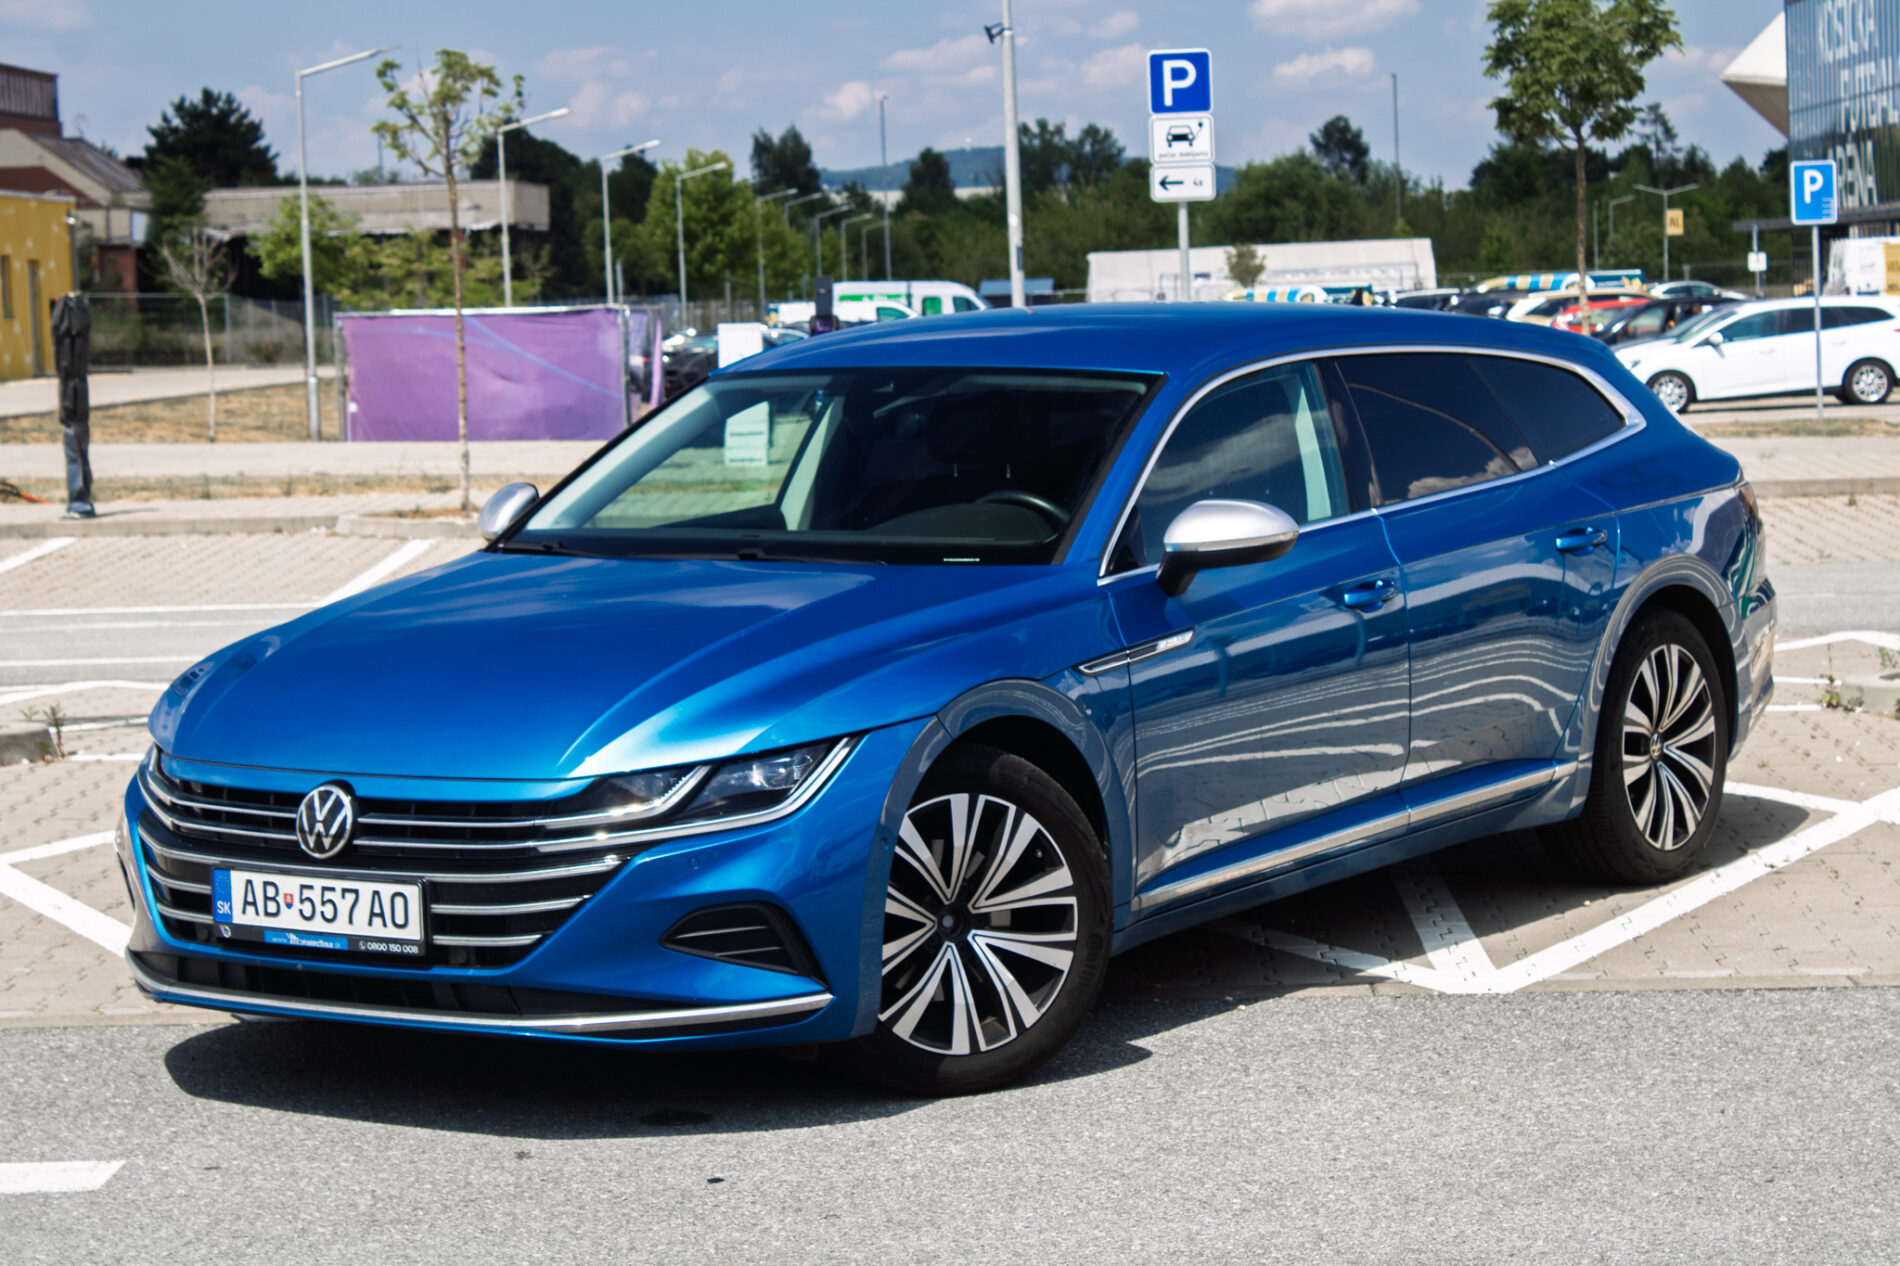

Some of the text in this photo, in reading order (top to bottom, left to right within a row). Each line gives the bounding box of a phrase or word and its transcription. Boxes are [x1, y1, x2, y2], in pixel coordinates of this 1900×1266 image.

[1162, 59, 1197, 107] P
[1803, 169, 1824, 204] P
[217, 900, 231, 914] SK
[241, 878, 281, 918] AB
